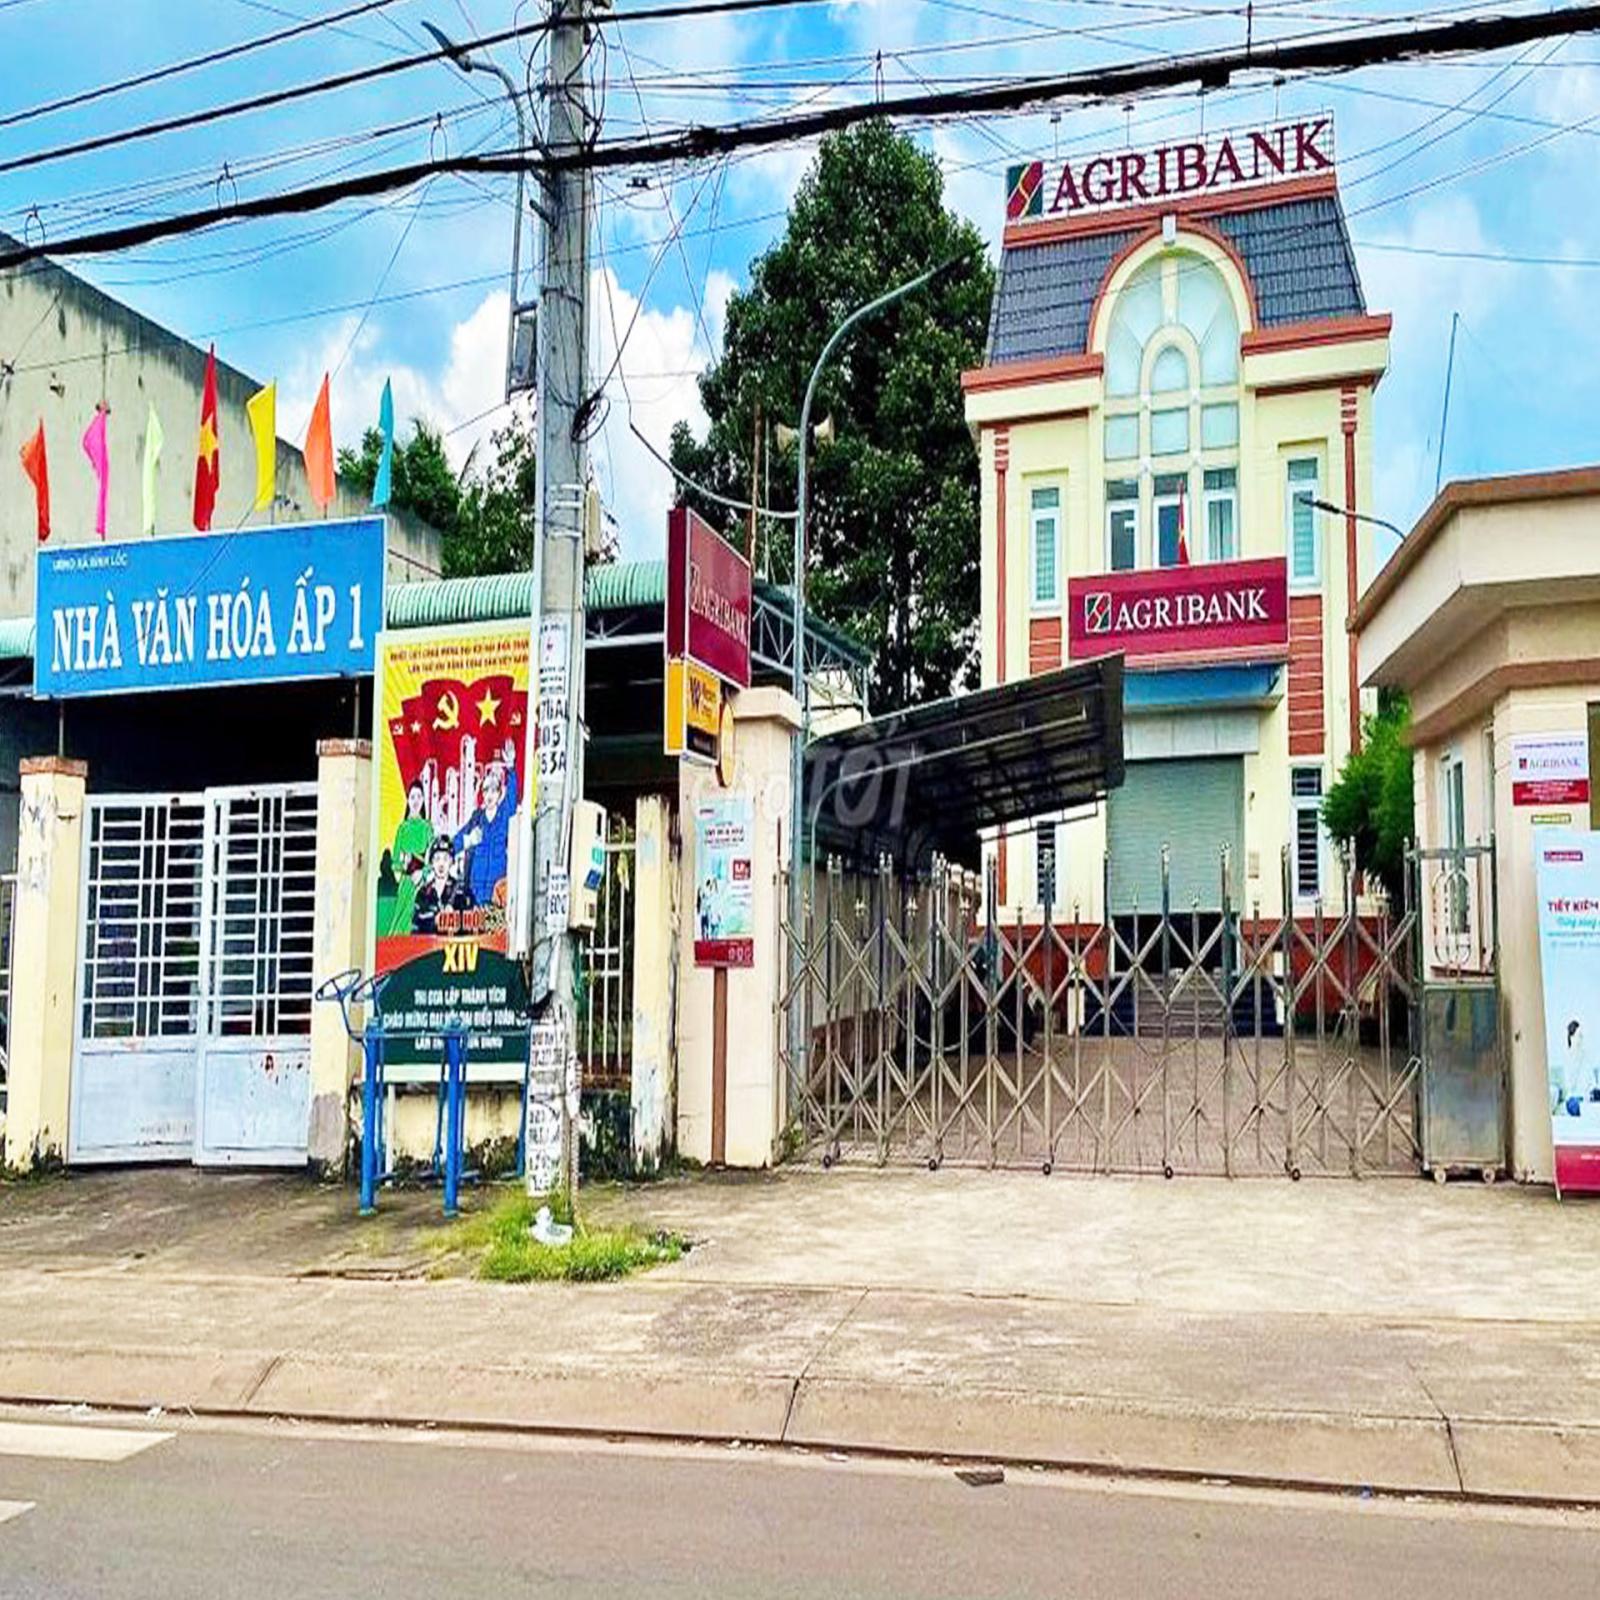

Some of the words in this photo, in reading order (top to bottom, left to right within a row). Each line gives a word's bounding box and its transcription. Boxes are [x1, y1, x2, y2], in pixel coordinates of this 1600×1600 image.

[1048, 119, 1334, 212] AGRIBANK
[51, 590, 123, 672] NHÀ
[131, 588, 198, 666] VĂN
[206, 577, 277, 661] HÓA
[287, 565, 338, 654] ẤP
[348, 583, 364, 650] 1
[700, 584, 747, 646] AGRIBANK
[1114, 588, 1269, 631] AGRIBANK
[443, 942, 479, 973] XIV
